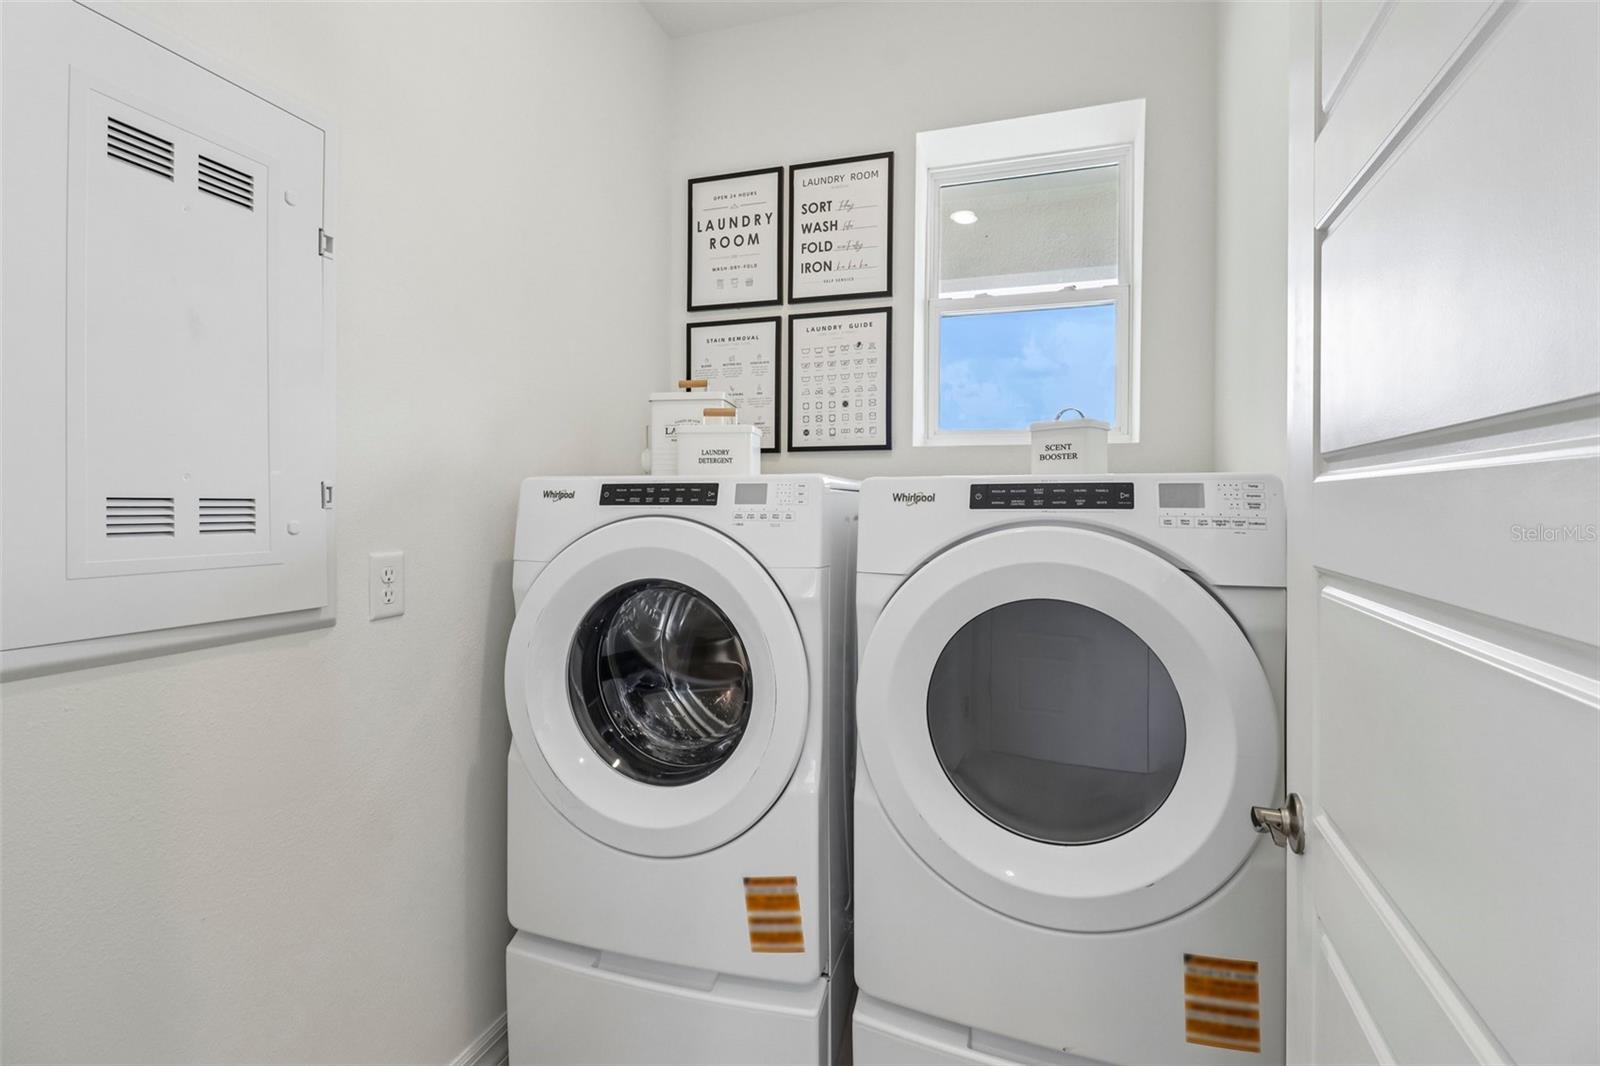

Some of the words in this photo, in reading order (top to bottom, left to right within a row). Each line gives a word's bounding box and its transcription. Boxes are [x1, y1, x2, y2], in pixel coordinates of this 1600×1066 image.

[802, 174, 846, 188] LAUNDRY
[850, 169, 879, 182] ROOM
[738, 190, 757, 198] HOURS
[801, 200, 833, 215] SORT
[697, 212, 773, 233] LAUNDRY
[801, 219, 838, 235] WASH
[709, 232, 760, 250] ROOM
[801, 240, 833, 254] FOLD
[800, 260, 832, 274] IRON
[805, 324, 843, 333] LAUNDRY
[848, 321, 873, 329] GUIDE
[1044, 442, 1073, 452] SCENT
[1039, 452, 1079, 461] BOOSTER
[542, 490, 576, 502] Whirlpool
[892, 492, 936, 506] Whirlpool
